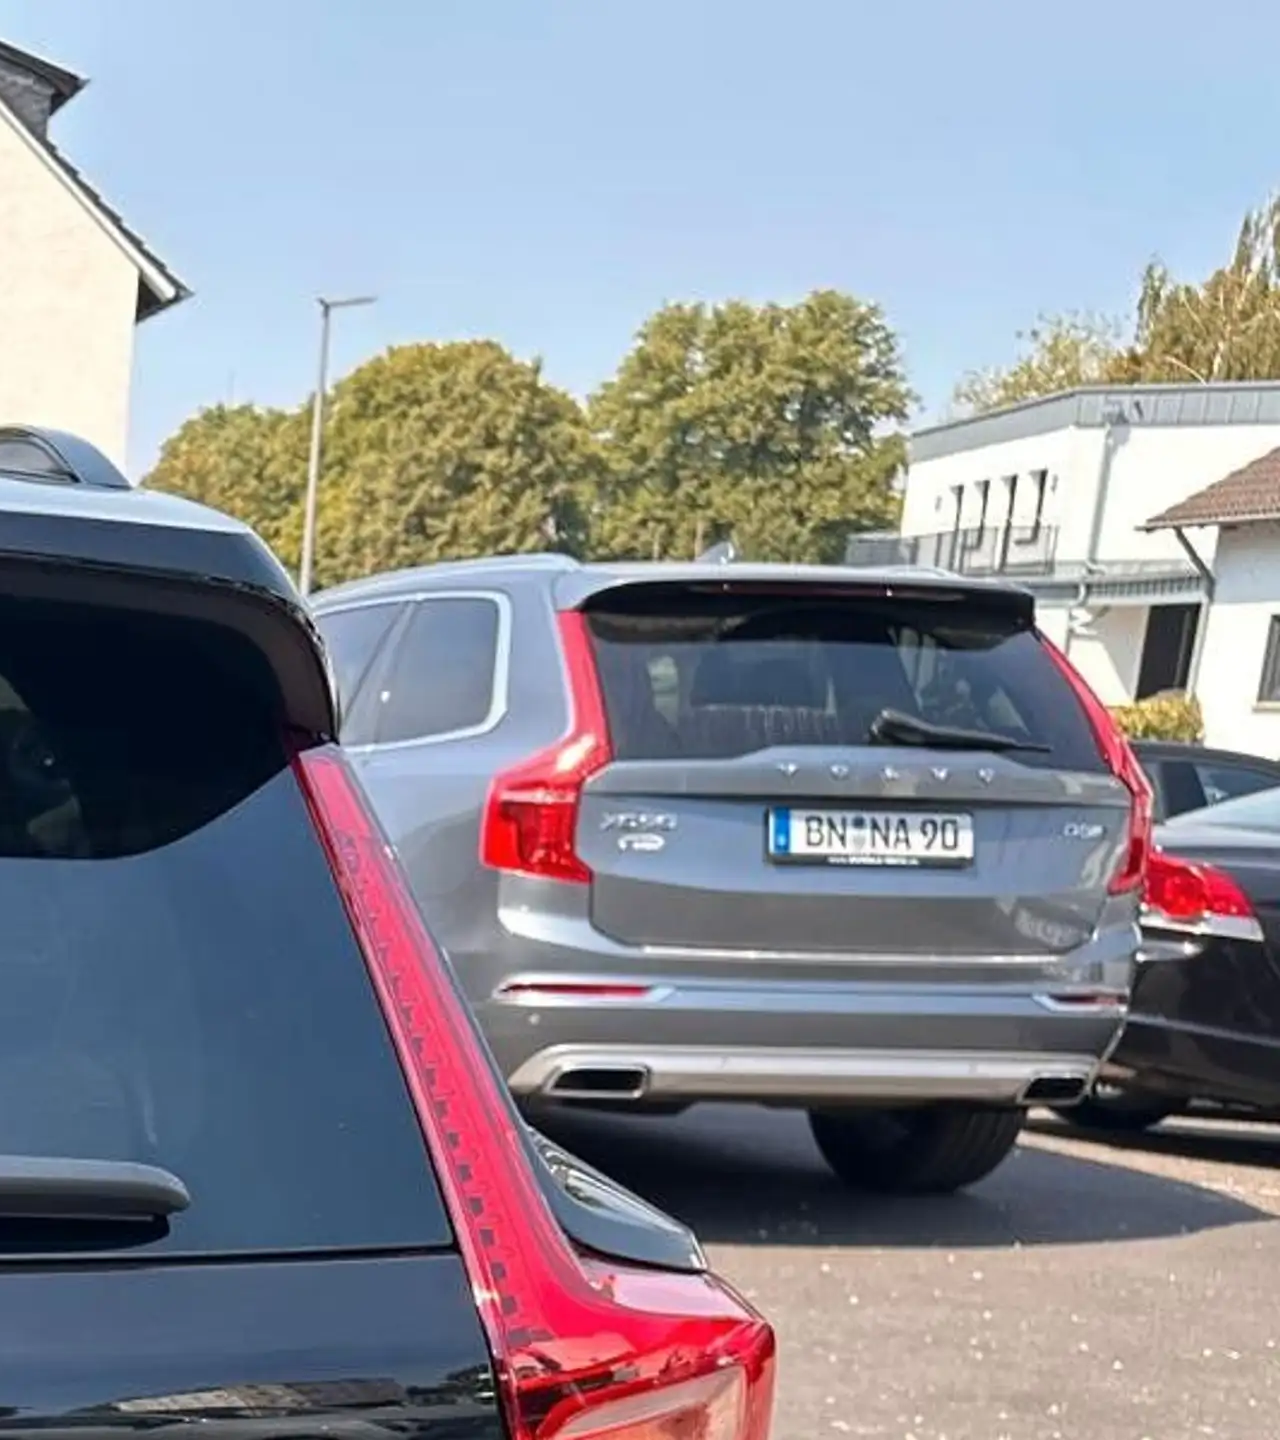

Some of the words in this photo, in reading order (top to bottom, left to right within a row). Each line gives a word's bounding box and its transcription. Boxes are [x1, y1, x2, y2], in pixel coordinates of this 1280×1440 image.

[804, 815, 847, 849] BN
[870, 816, 912, 850] NA
[919, 818, 959, 851] 90
